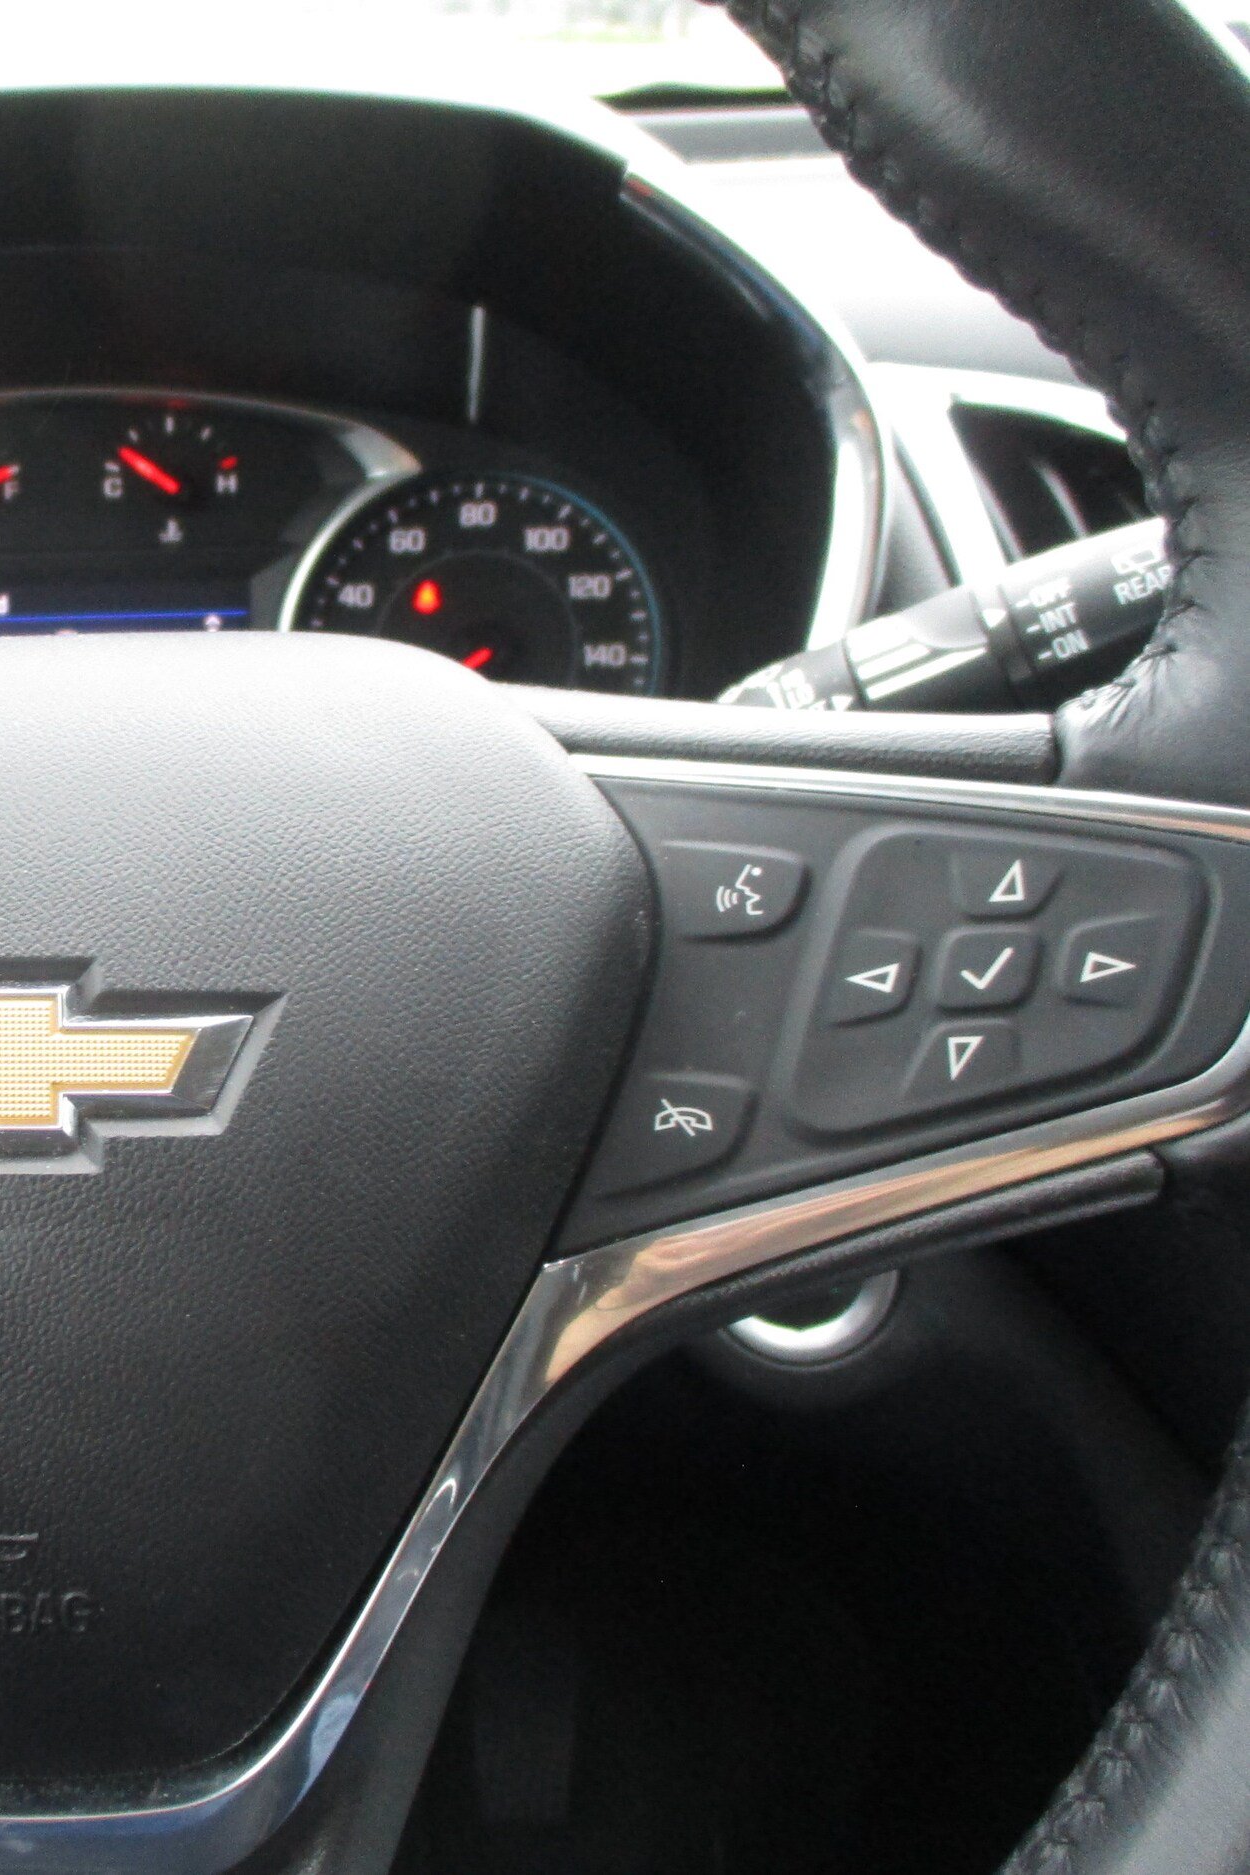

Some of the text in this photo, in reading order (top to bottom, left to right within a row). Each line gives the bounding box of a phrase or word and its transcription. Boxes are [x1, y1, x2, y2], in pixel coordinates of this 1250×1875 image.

[458, 501, 497, 528] 80
[389, 527, 427, 554] 60
[524, 526, 570, 553] 100
[337, 582, 375, 609] 40
[568, 573, 611, 600] 120
[1039, 602, 1077, 633] INT
[583, 643, 628, 668] 140
[1051, 629, 1090, 659] ON
